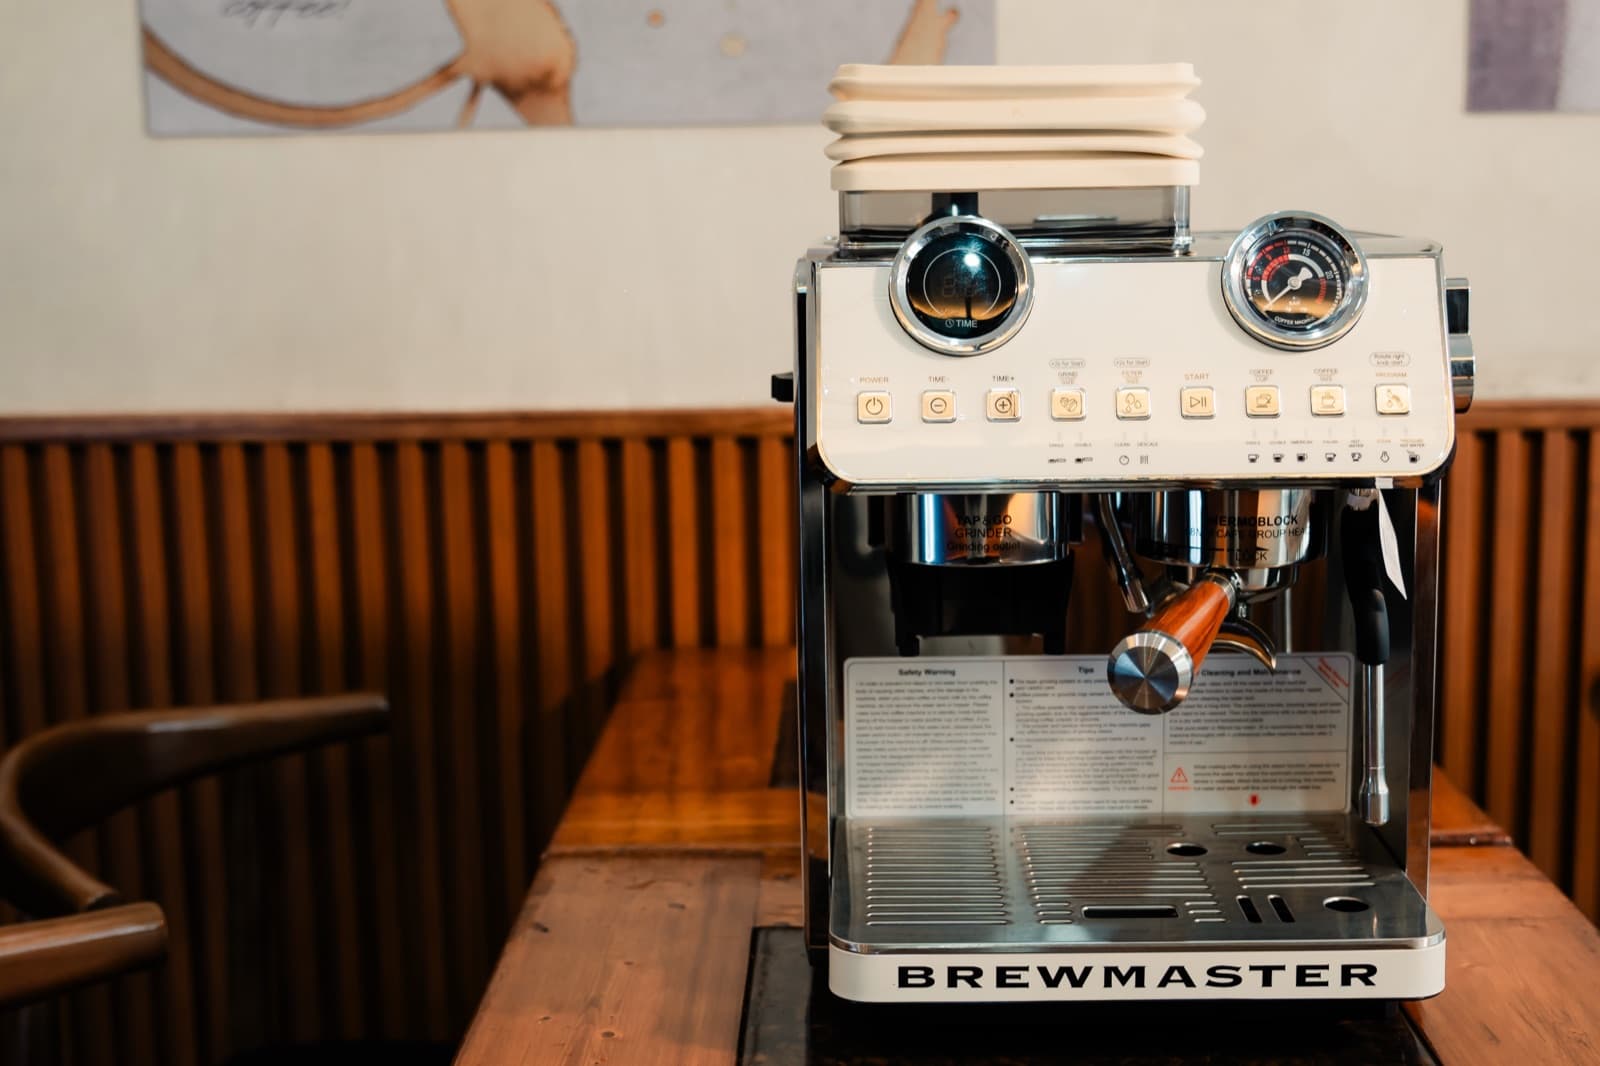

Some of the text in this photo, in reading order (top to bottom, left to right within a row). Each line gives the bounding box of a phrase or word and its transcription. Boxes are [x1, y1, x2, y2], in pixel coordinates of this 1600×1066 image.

[1302, 248, 1311, 256] 15
[956, 319, 978, 328] TIME
[955, 527, 1012, 538] GRINDER
[898, 964, 1378, 989] BREWMASTER
